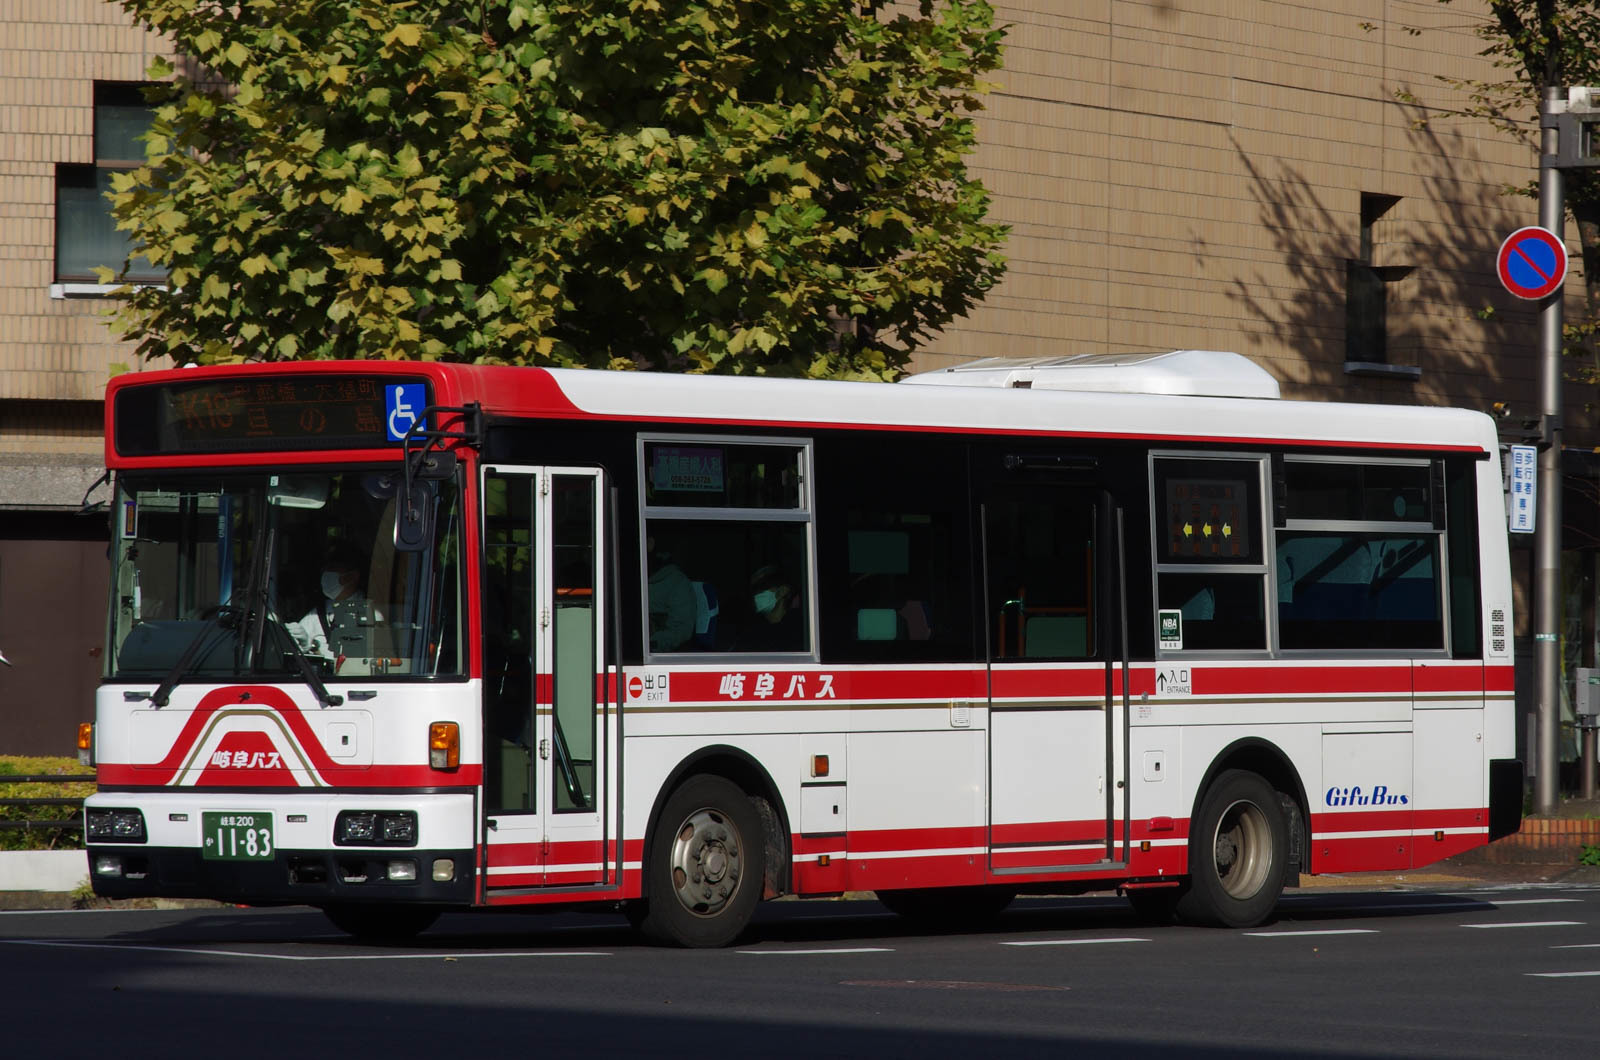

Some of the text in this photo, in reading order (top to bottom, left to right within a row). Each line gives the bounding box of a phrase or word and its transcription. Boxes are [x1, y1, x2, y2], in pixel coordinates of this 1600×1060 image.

[1162, 618, 1177, 629] NBA
[644, 674, 667, 689] 出口
[1170, 670, 1188, 683] 入口
[718, 673, 836, 699] 岐阜バス
[1166, 686, 1191, 694] ENTRANCE
[647, 692, 664, 701] EXIT
[211, 750, 282, 768] 岐阜バス
[217, 828, 271, 856] 11-83
